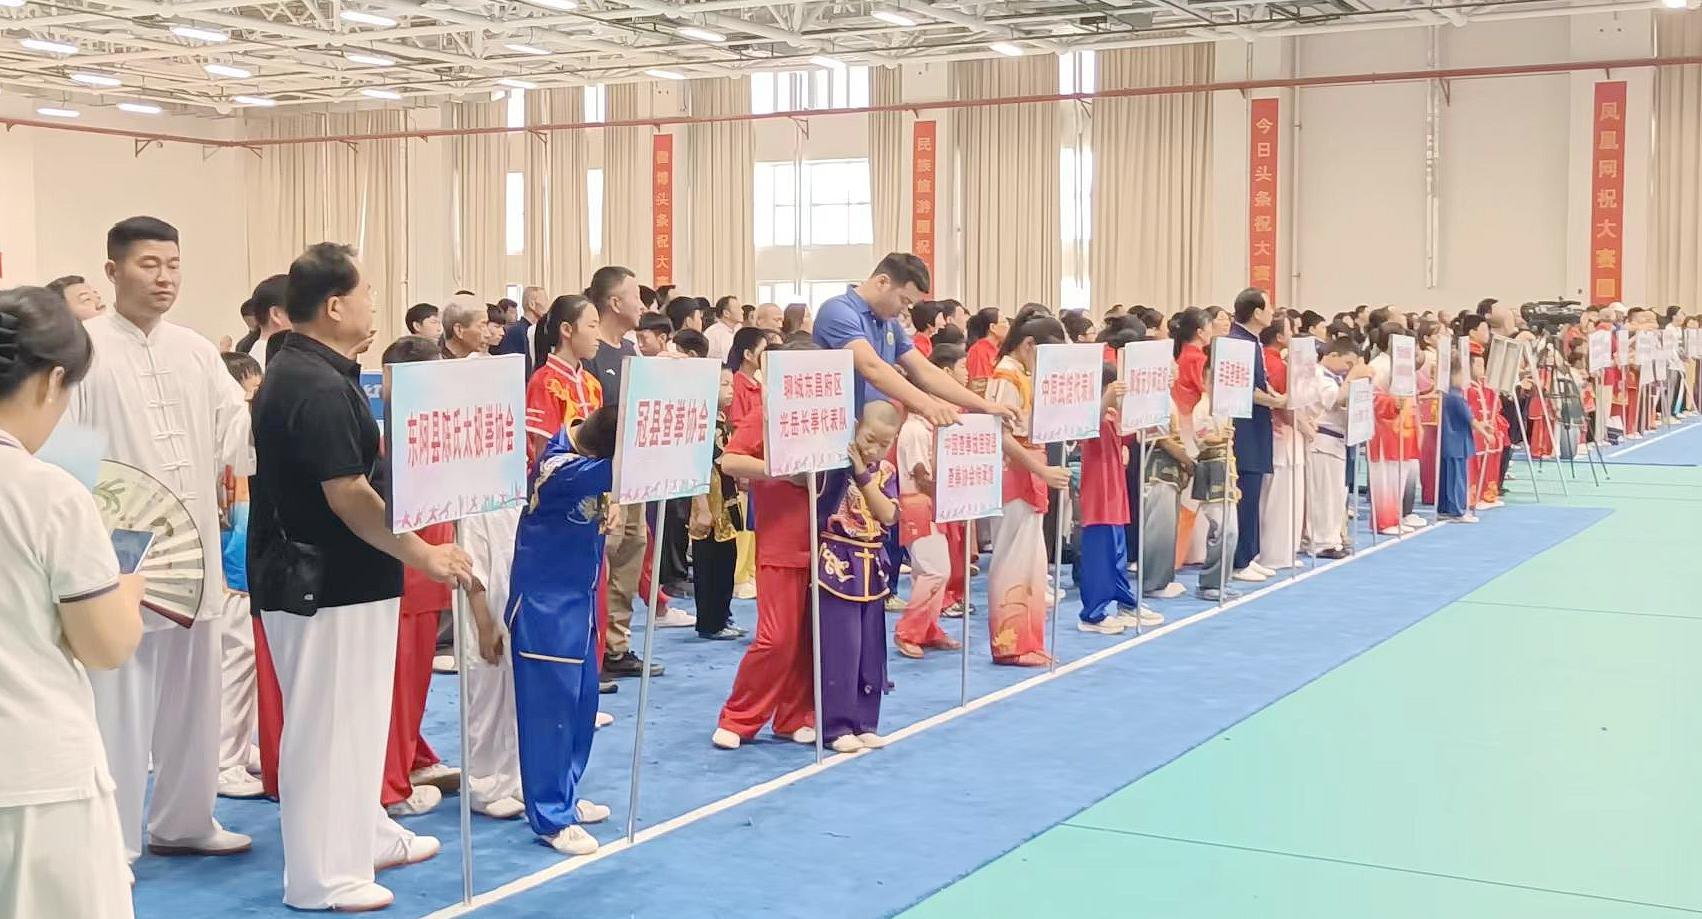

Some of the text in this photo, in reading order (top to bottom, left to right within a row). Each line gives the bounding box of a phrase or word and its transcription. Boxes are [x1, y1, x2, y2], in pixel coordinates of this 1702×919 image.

[1254, 118, 1274, 297] 今日头条祝大赛
[783, 371, 843, 399] 聊城东昌府区
[406, 402, 514, 467] 东阿县陈氏太极拳协会
[635, 398, 708, 448] 冠县查拳协会
